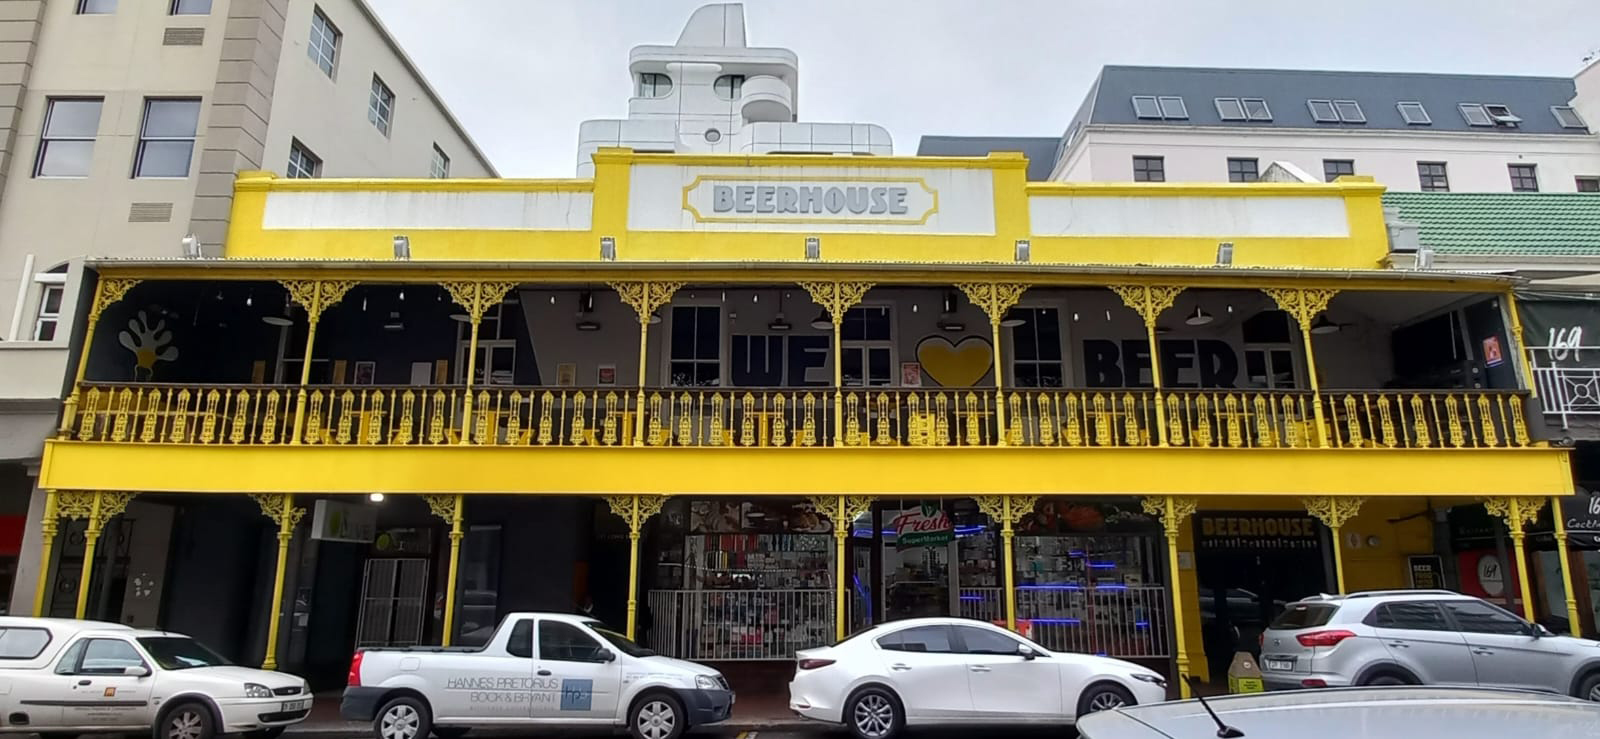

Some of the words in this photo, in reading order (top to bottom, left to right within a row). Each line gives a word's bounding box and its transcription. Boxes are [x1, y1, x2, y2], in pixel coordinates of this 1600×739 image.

[713, 185, 908, 215] BEERHOUSE
[1547, 326, 1583, 362] 169
[731, 335, 831, 387] WE
[1083, 339, 1238, 388] BEER
[892, 511, 952, 535] Fresh
[1202, 518, 1315, 536] BEERHOUSE
[447, 677, 494, 689] HANNES
[497, 678, 558, 689] PRETORIUS
[470, 691, 502, 703] BOCK
[504, 692, 512, 703] &
[514, 692, 556, 703] BRYANT
